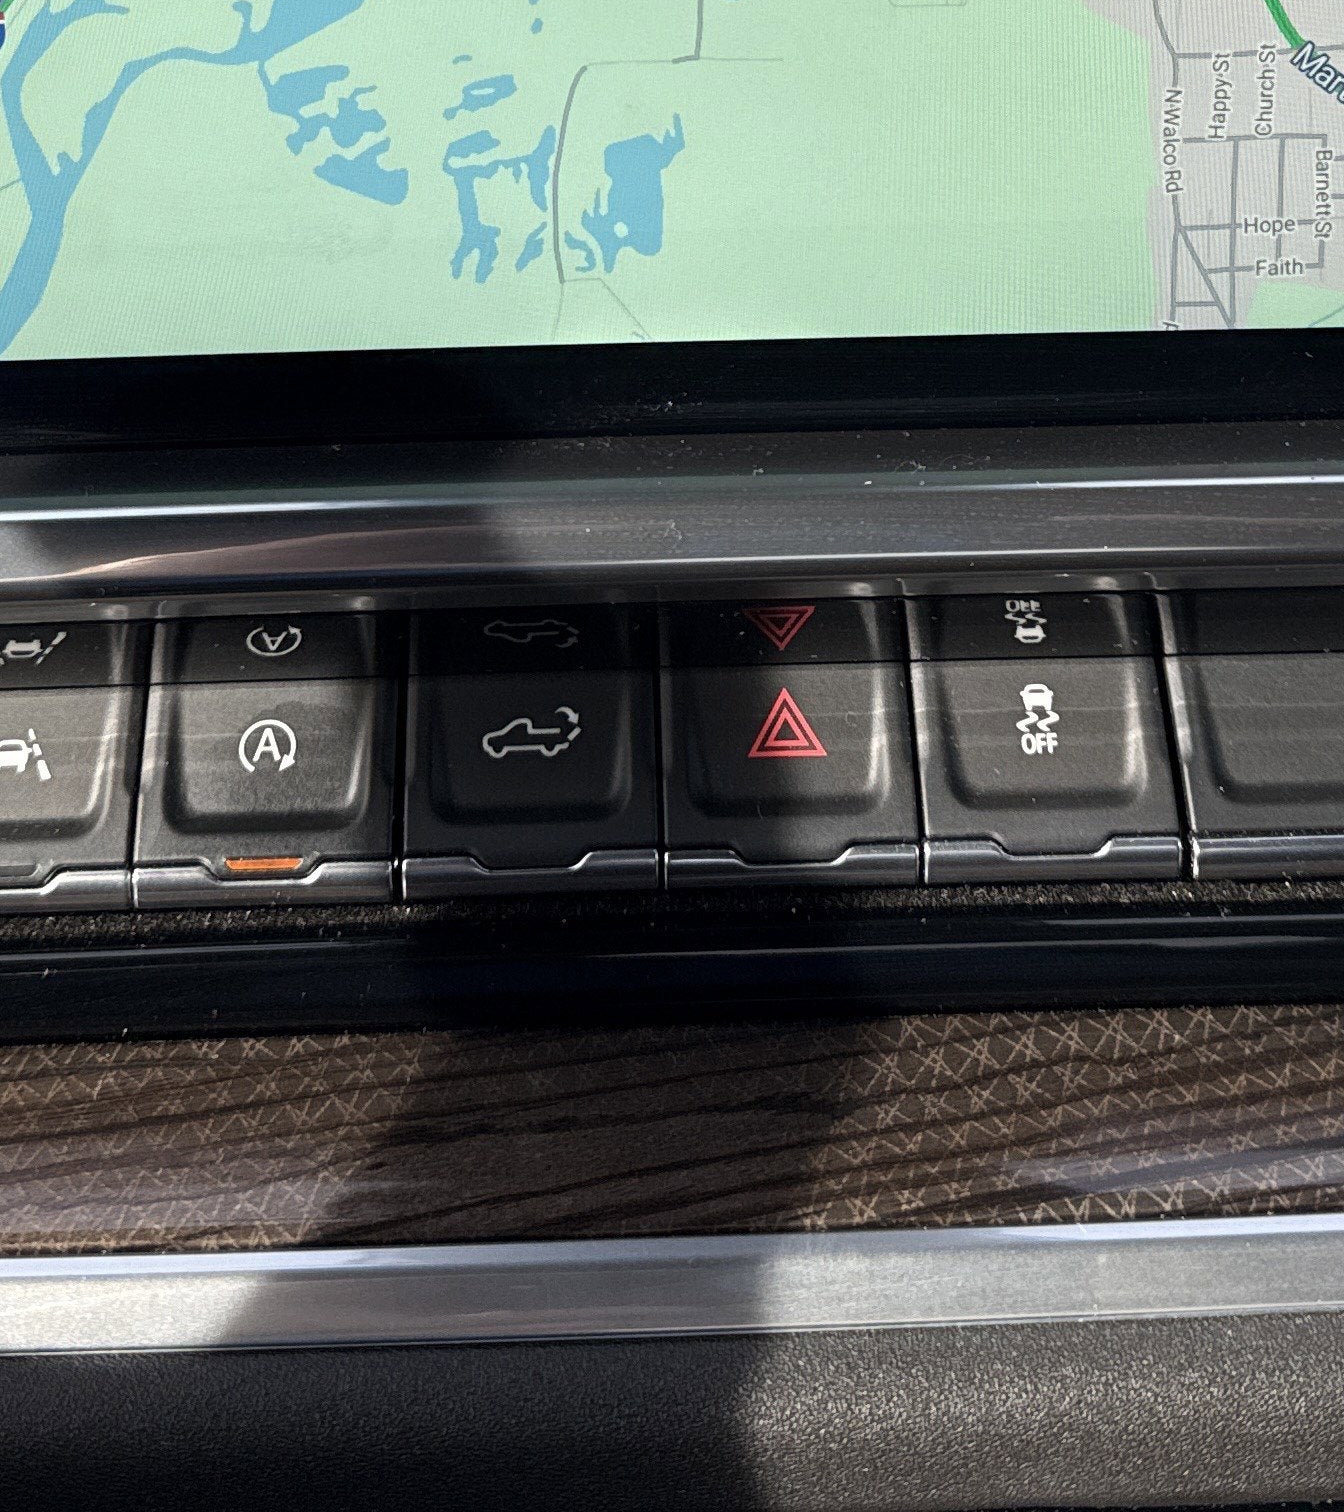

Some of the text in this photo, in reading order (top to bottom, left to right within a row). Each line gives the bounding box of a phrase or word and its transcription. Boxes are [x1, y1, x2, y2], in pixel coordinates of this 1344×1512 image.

[1209, 52, 1233, 140] Happy St
[1254, 45, 1276, 137] Church St
[1164, 89, 1183, 194] N Walco Rd
[1243, 217, 1297, 237] Hope
[1313, 149, 1333, 240] Barnett St
[1255, 258, 1304, 276] Faith
[1021, 732, 1058, 755] OFF
